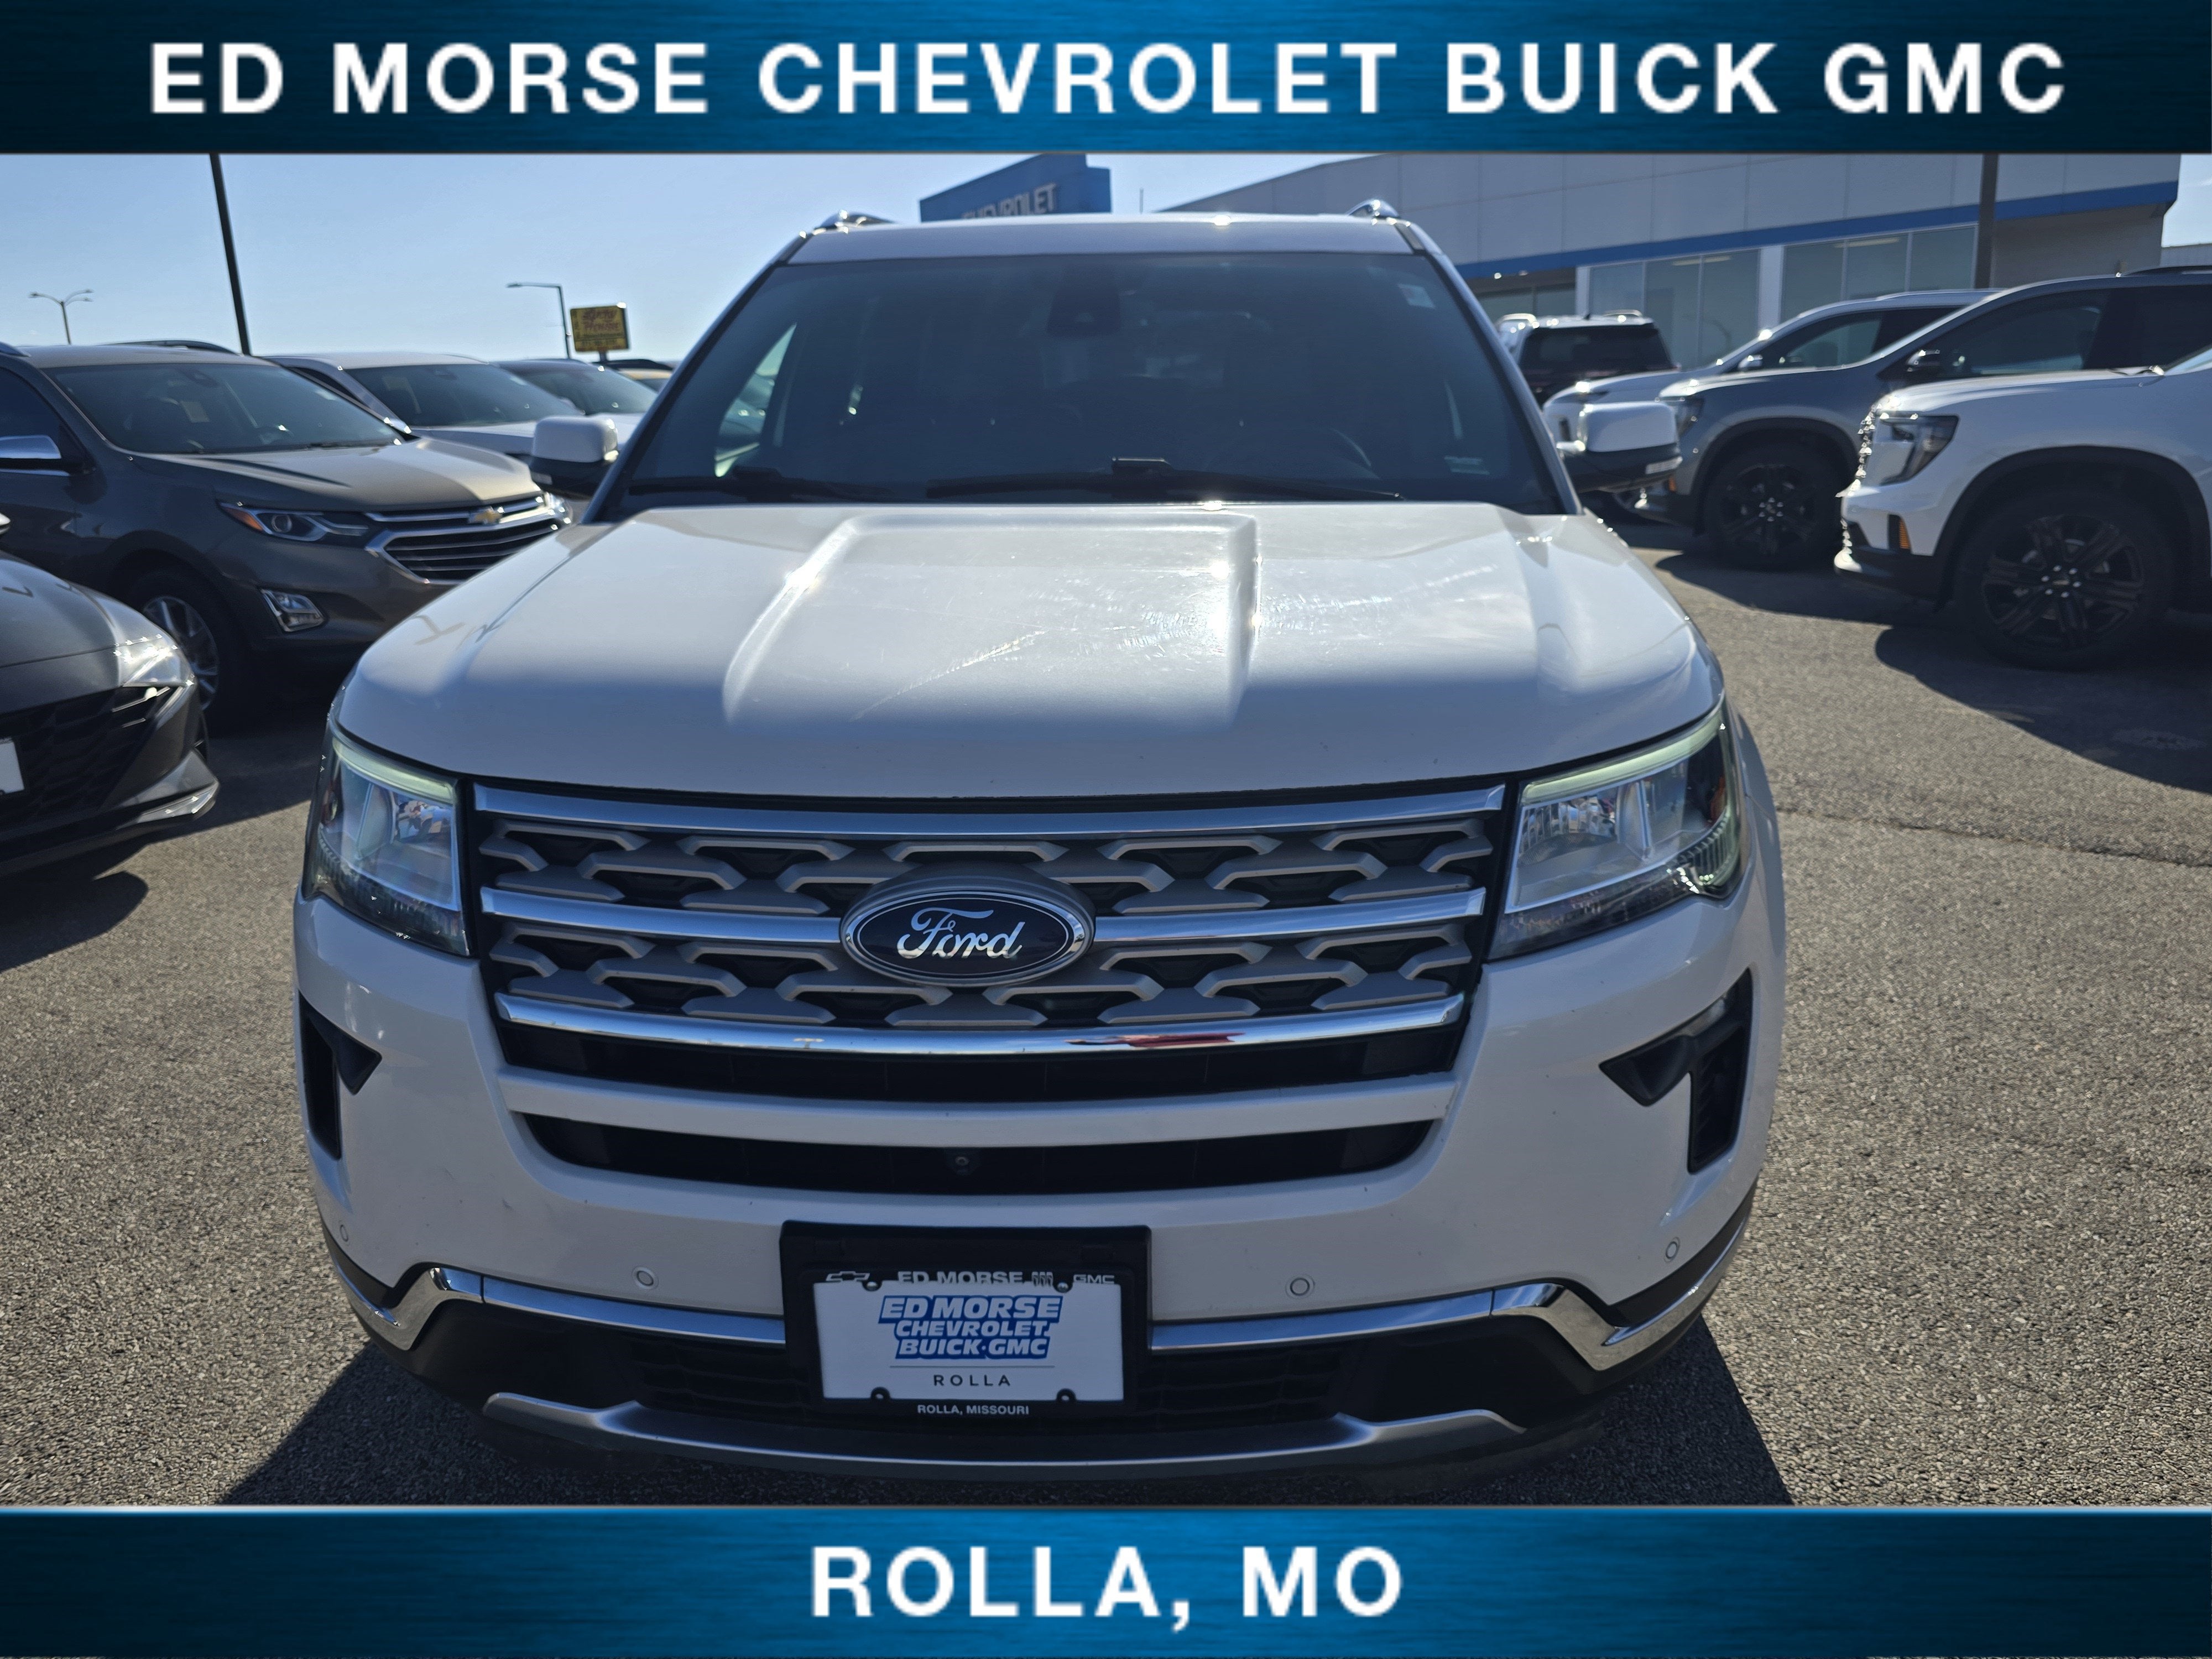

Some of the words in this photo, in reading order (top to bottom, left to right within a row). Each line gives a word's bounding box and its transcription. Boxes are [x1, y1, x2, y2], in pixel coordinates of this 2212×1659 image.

[962, 183, 1057, 219] EVROLET
[897, 907, 1025, 959] Ford
[898, 1271, 929, 1284] ED
[937, 1271, 1023, 1284] MORSE
[1073, 1274, 1115, 1284] GMC
[881, 1297, 928, 1319] ED
[932, 1297, 1061, 1319] MORSE
[896, 1320, 1048, 1337] CHEVROLET
[933, 1374, 1011, 1386] ROLLA
[917, 1404, 963, 1415] ROLLA,
[966, 1405, 1030, 1415] MISSOURI
